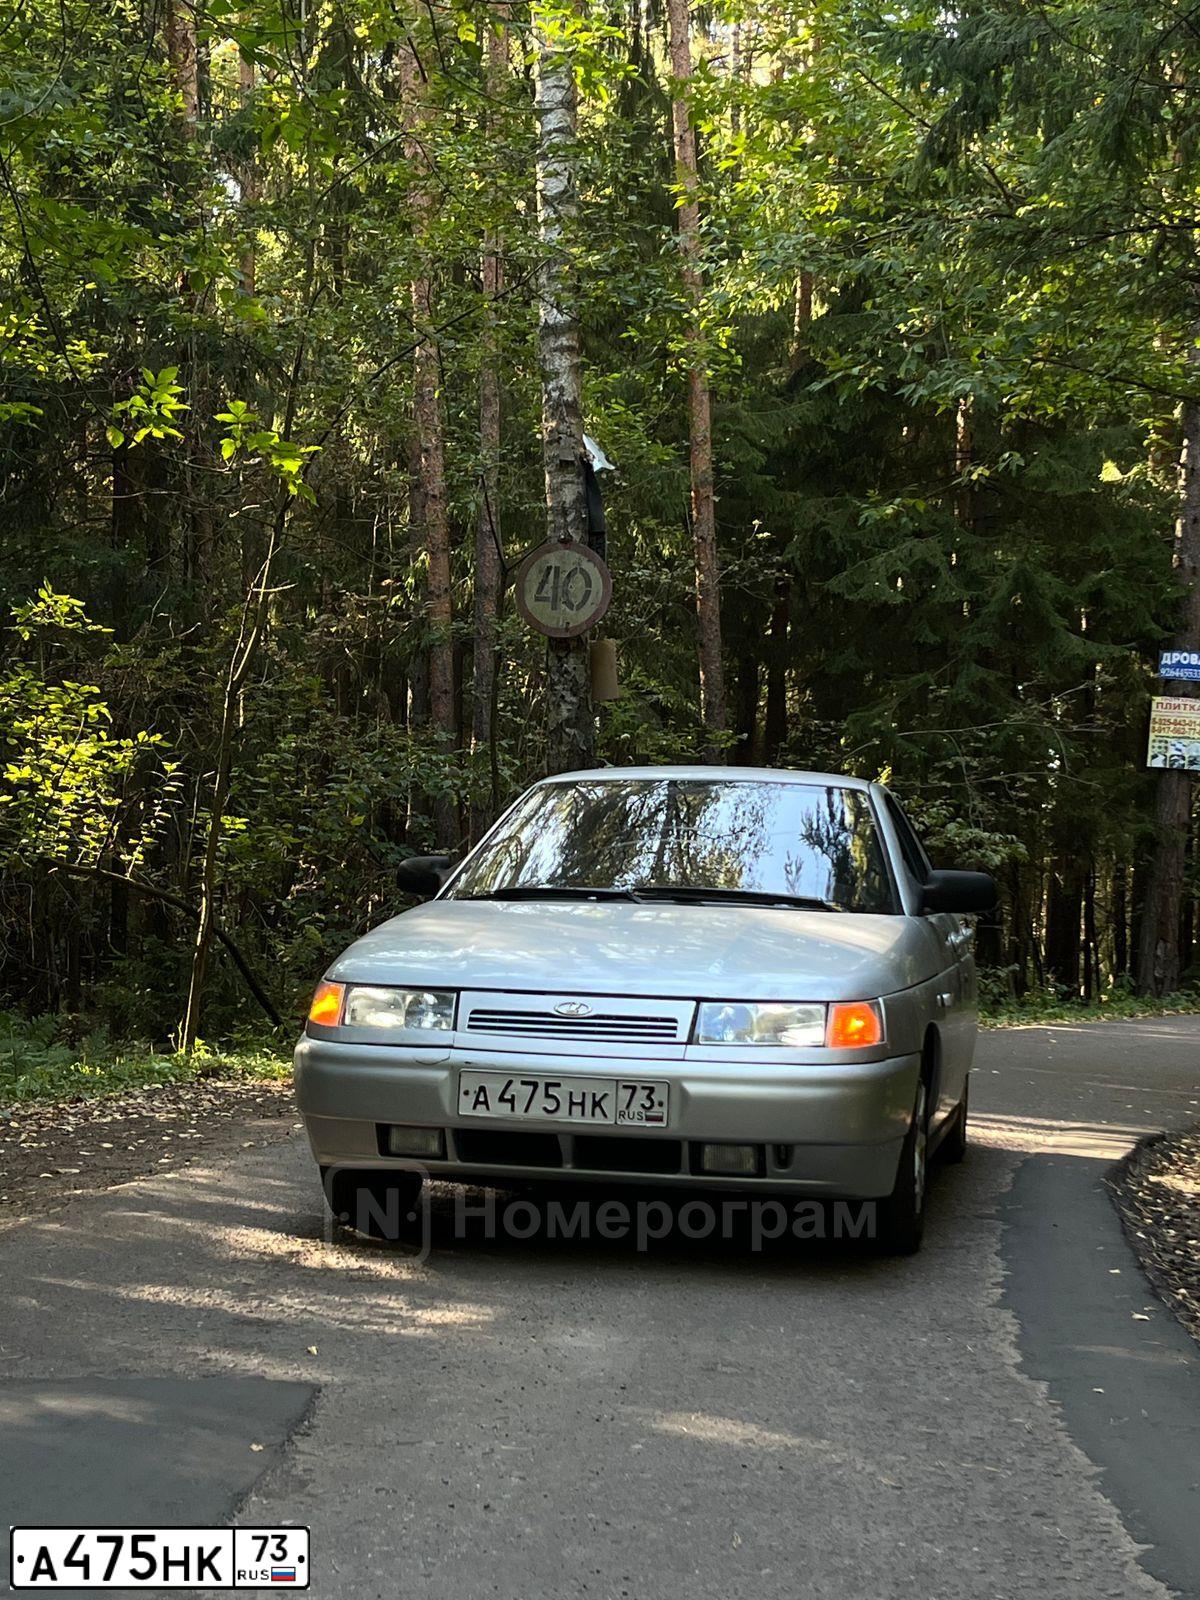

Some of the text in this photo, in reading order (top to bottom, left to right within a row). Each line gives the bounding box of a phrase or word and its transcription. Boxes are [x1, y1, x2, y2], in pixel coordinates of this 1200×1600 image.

[534, 565, 592, 612] 40
[1161, 652, 1200, 665] ДРОВ
[472, 1079, 656, 1119] А475НК 73
[618, 1110, 644, 1121] RUS
